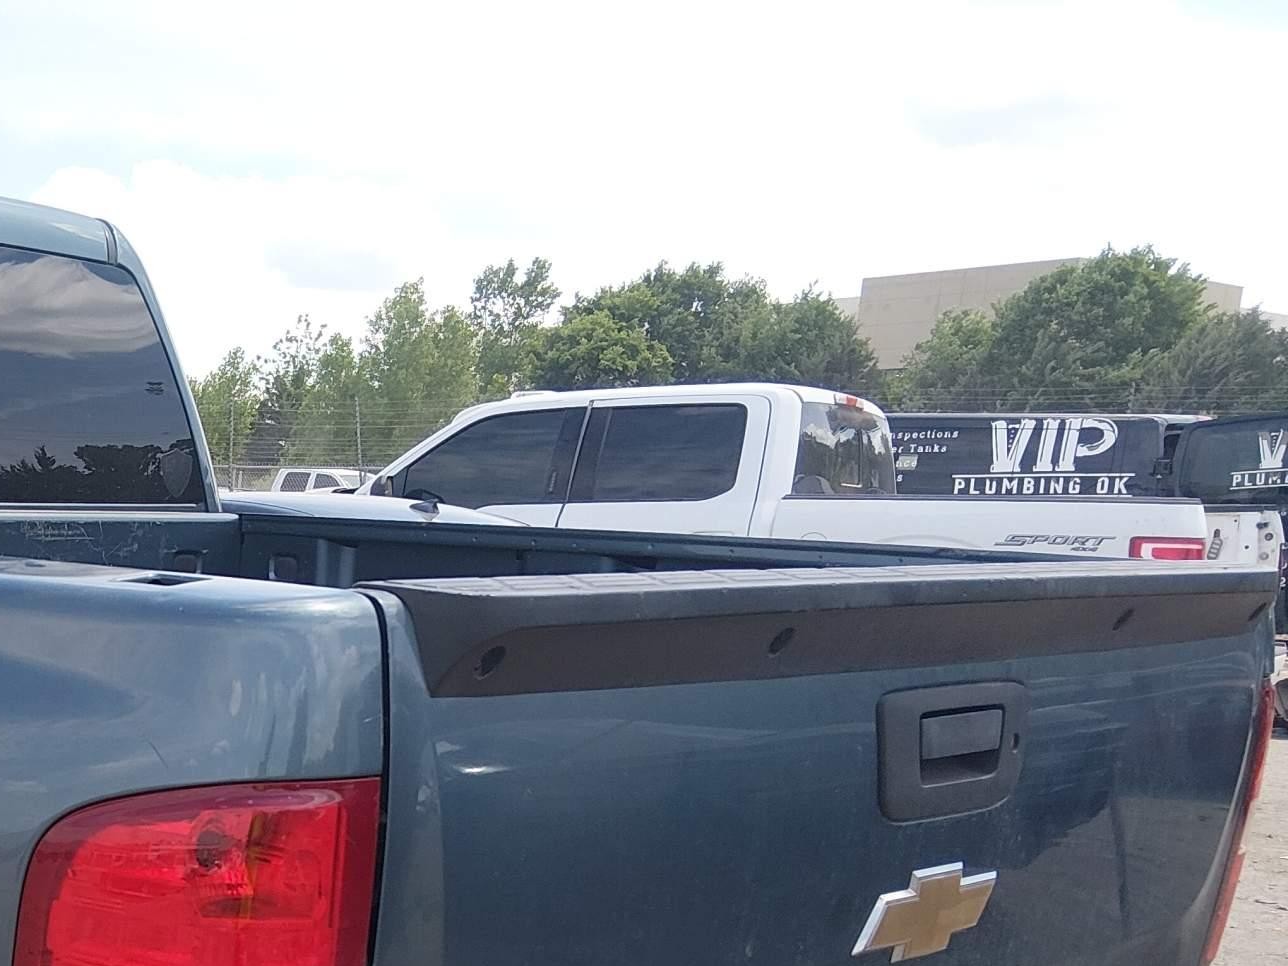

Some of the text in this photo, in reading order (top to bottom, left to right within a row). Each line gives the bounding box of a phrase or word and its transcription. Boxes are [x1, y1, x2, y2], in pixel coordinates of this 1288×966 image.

[910, 444, 947, 453] Tanks
[990, 417, 1118, 473] VIP
[953, 476, 1130, 494] PLUMBING OK
[994, 534, 1116, 546] SPORT
